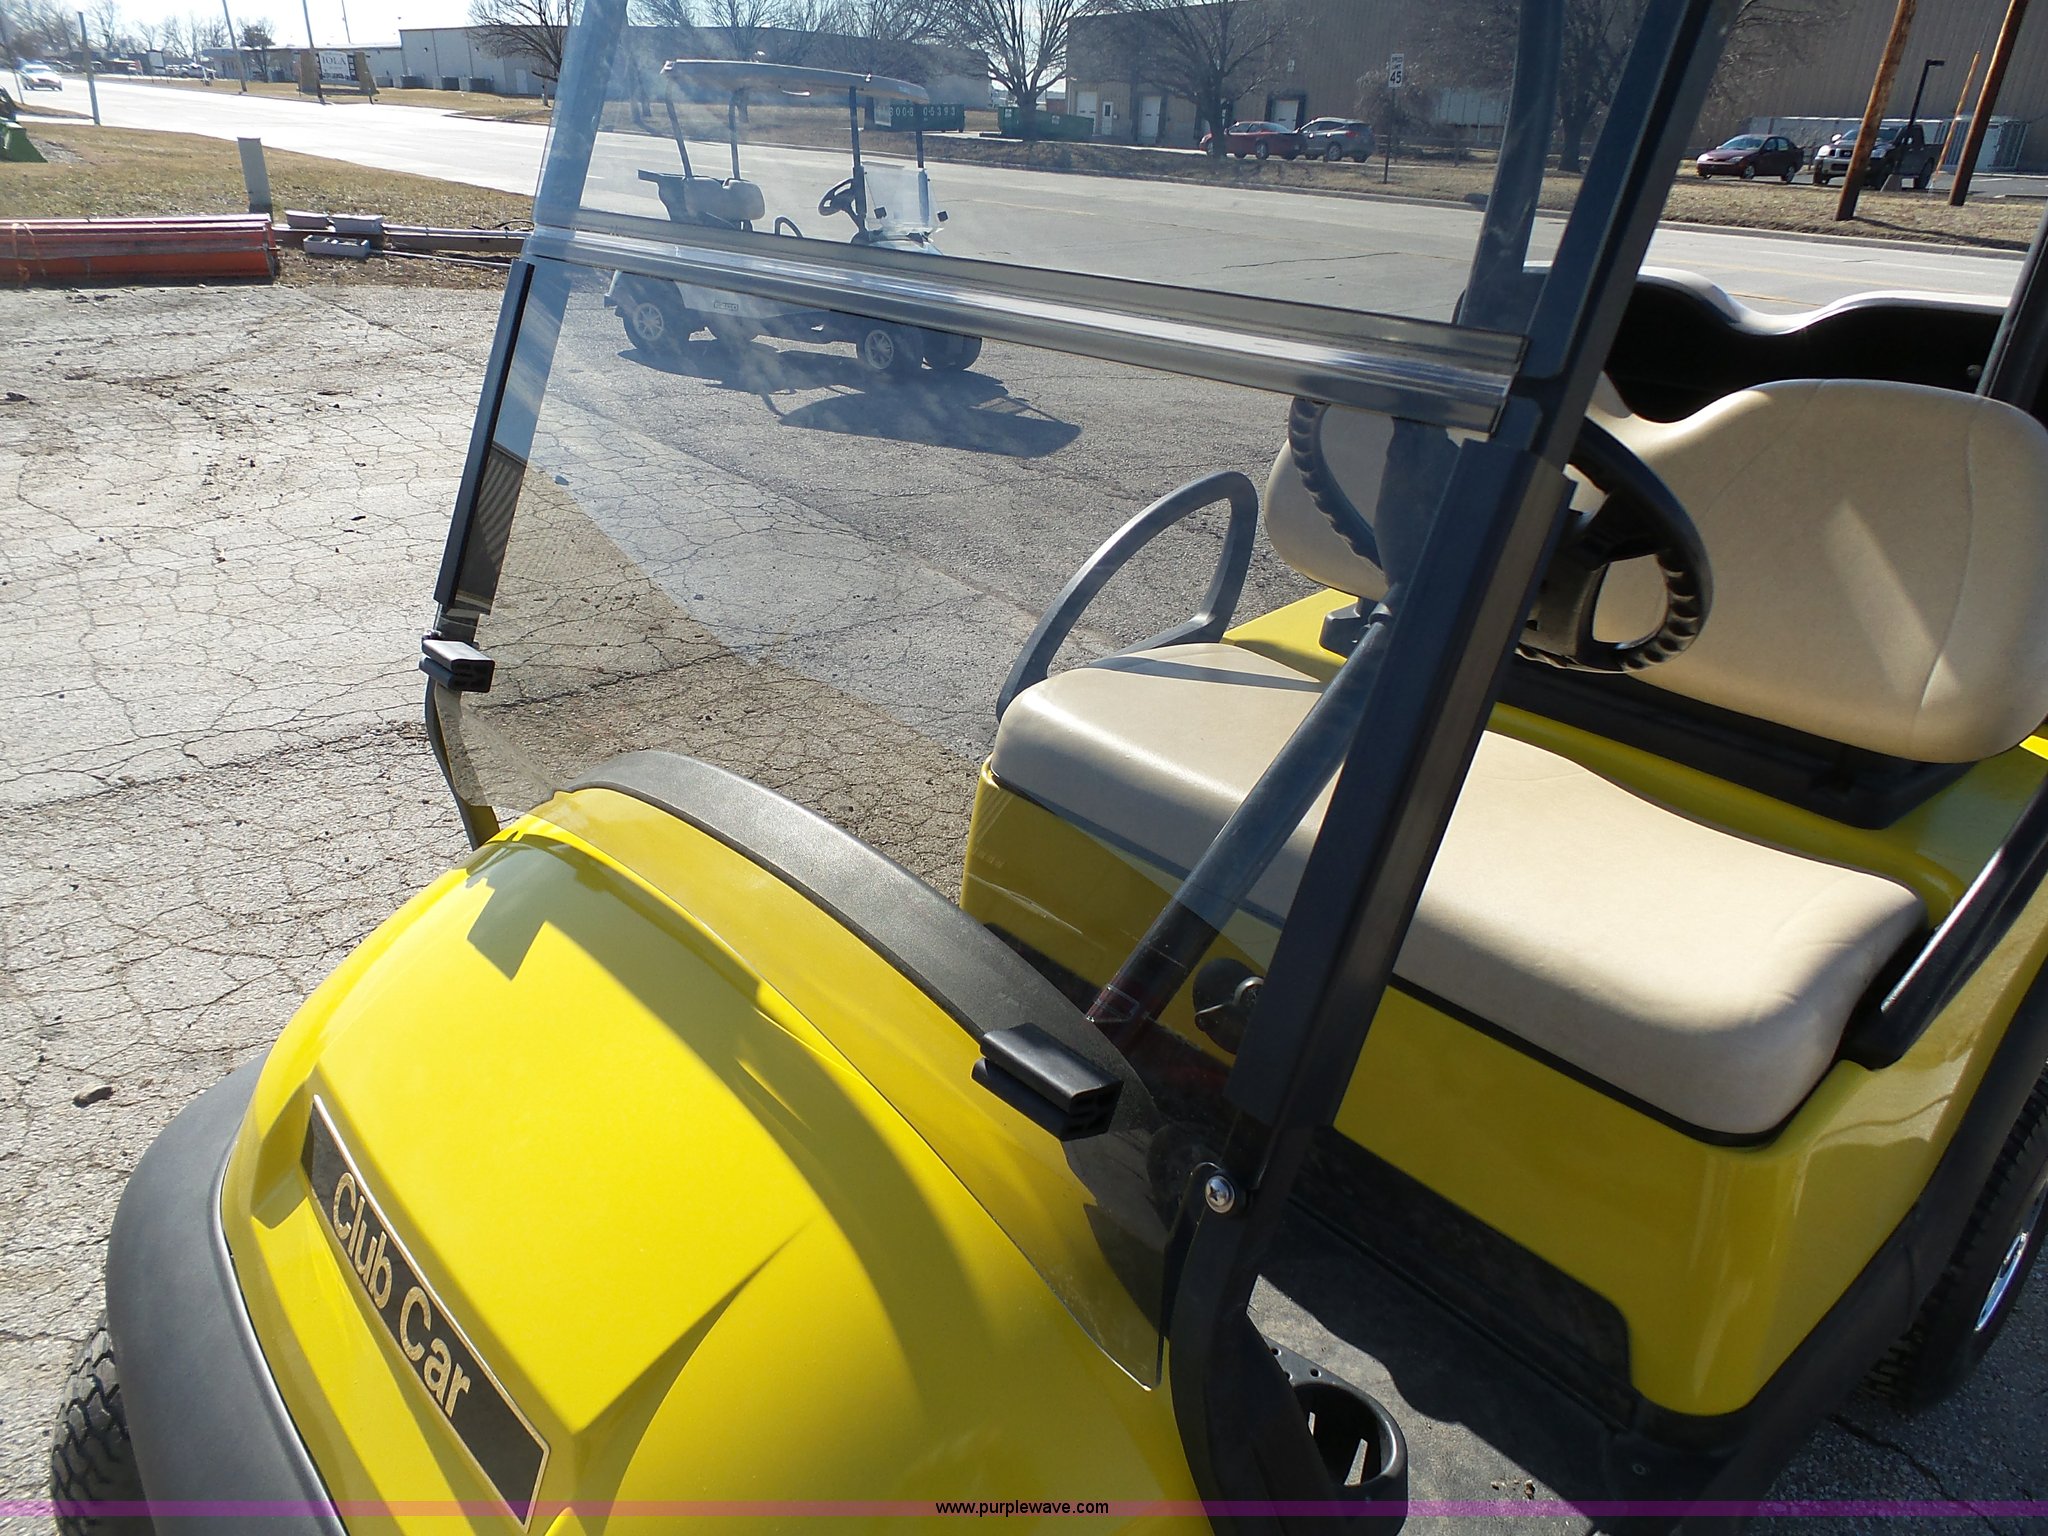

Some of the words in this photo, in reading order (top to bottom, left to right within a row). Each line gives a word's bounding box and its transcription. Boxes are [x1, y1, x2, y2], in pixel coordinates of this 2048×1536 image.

[1390, 71, 1402, 84] 45
[332, 1172, 393, 1309] Club
[400, 1286, 471, 1418] Car
